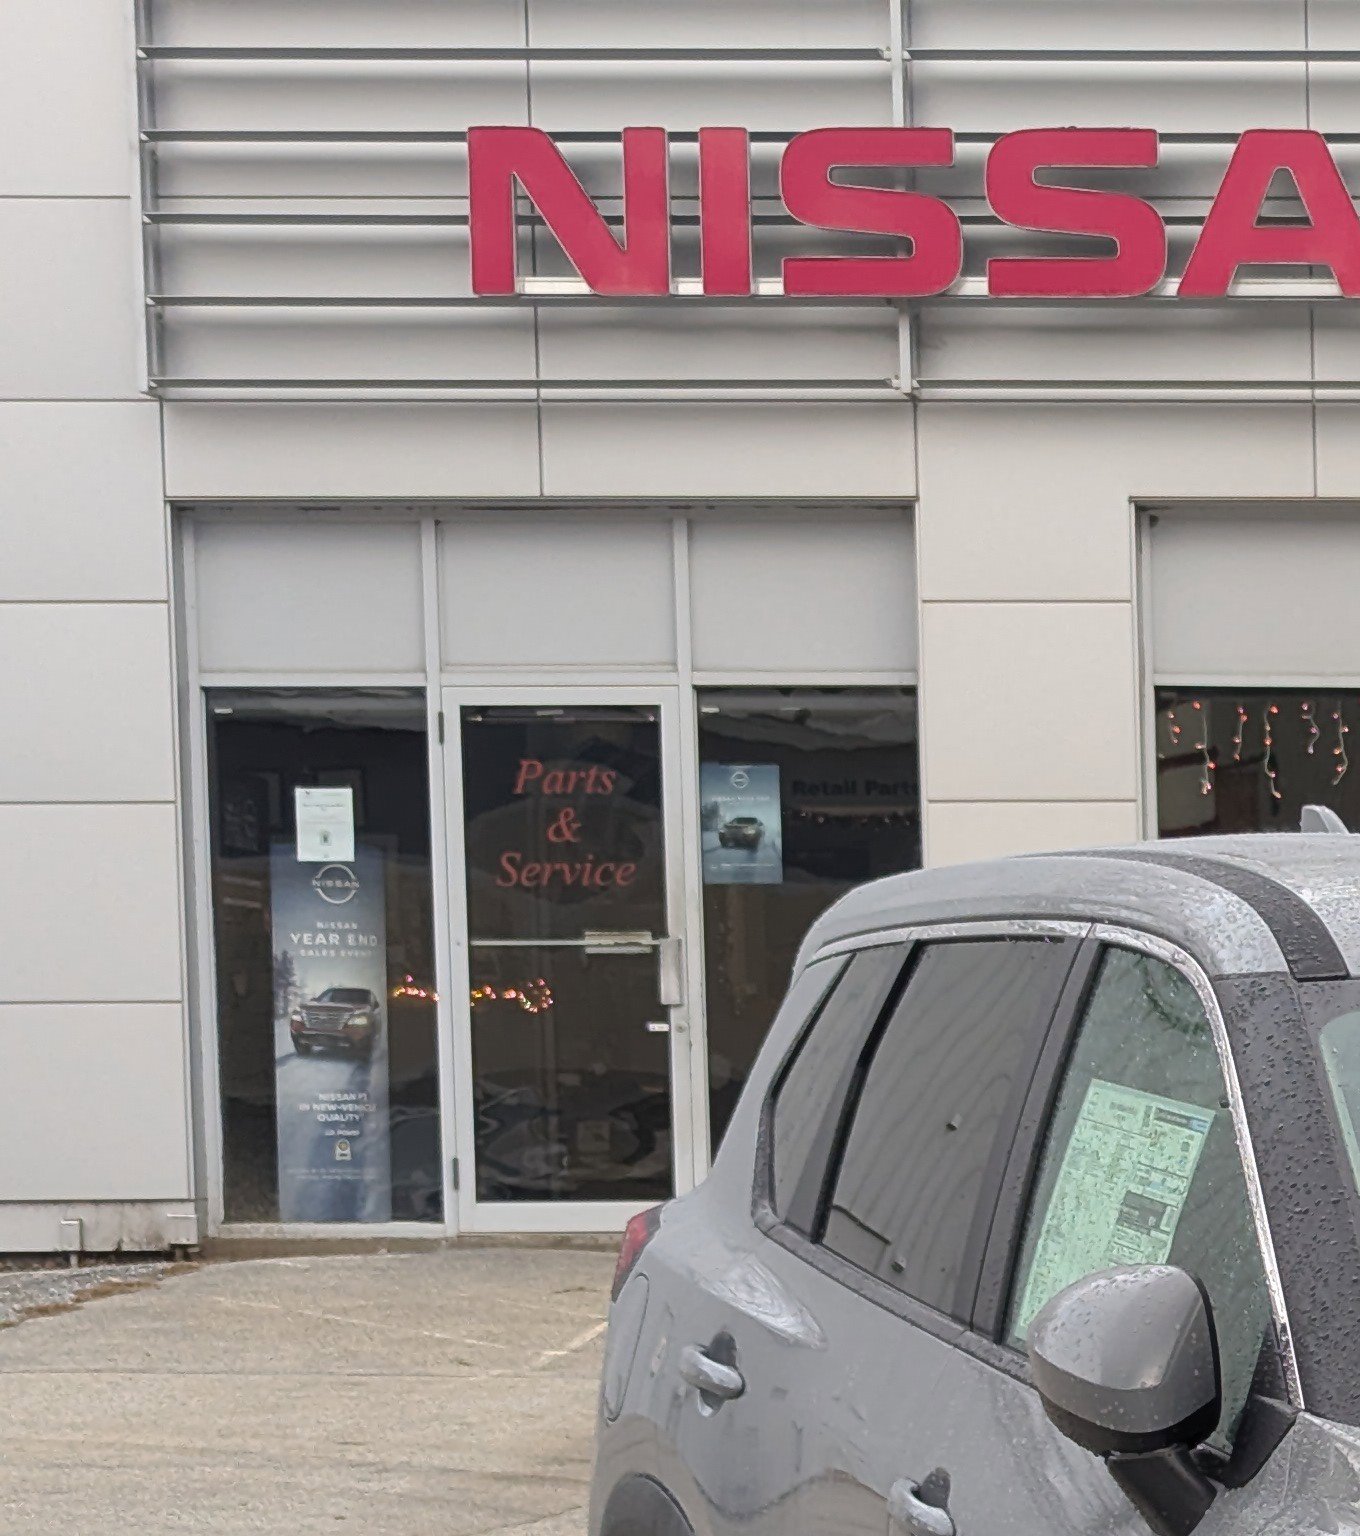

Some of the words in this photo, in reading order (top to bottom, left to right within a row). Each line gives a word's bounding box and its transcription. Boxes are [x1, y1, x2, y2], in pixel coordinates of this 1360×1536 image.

[512, 758, 617, 795] Parts
[792, 778, 857, 796] Retail
[546, 806, 583, 843] &
[495, 852, 638, 888] Service
[312, 879, 360, 889] NISSAN
[289, 932, 341, 946] YEAR
